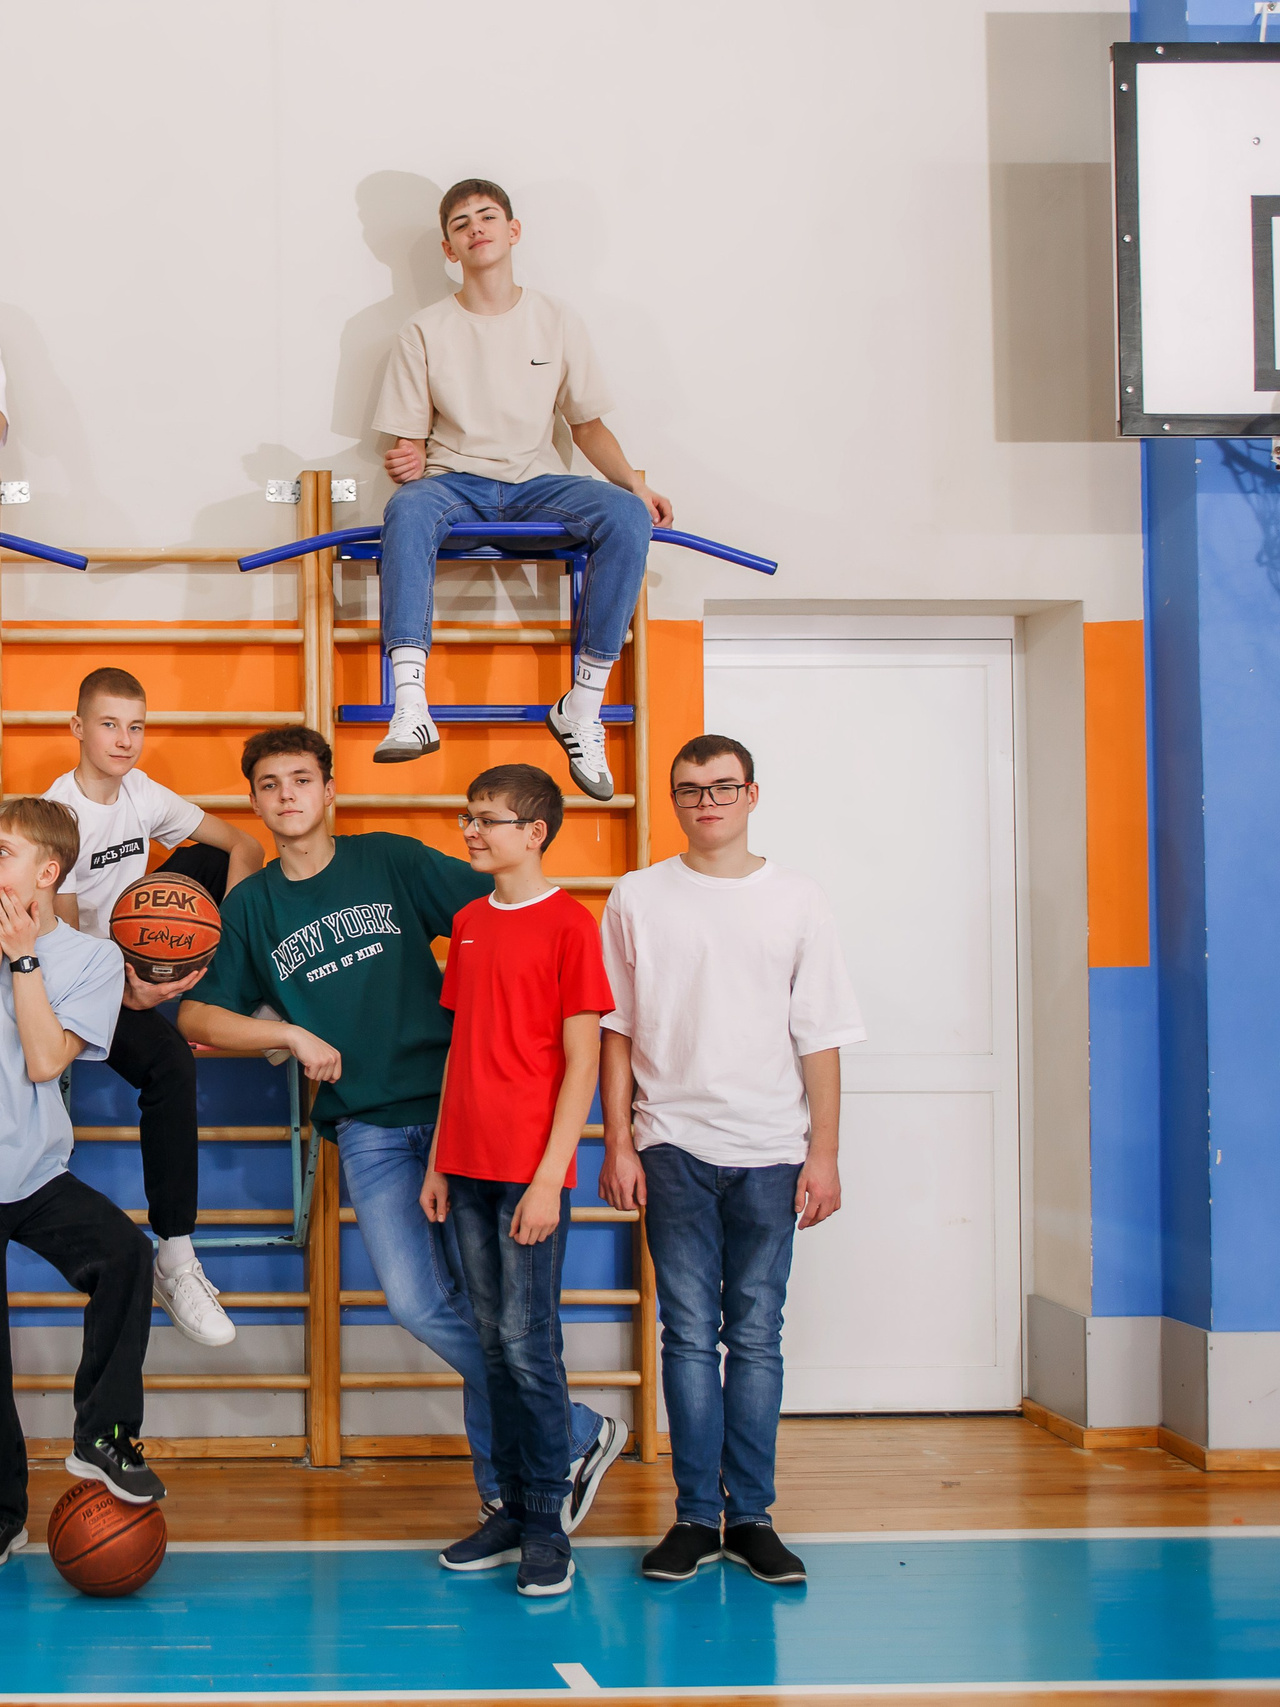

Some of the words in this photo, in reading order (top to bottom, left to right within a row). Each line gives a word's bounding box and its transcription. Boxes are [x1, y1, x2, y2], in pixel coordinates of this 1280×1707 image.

[133, 889, 198, 915] PEAK
[271, 920, 324, 981] NEW
[321, 903, 401, 944] YORK
[306, 961, 338, 982] STATE
[340, 954, 353, 968] OF
[354, 942, 383, 961] MIND
